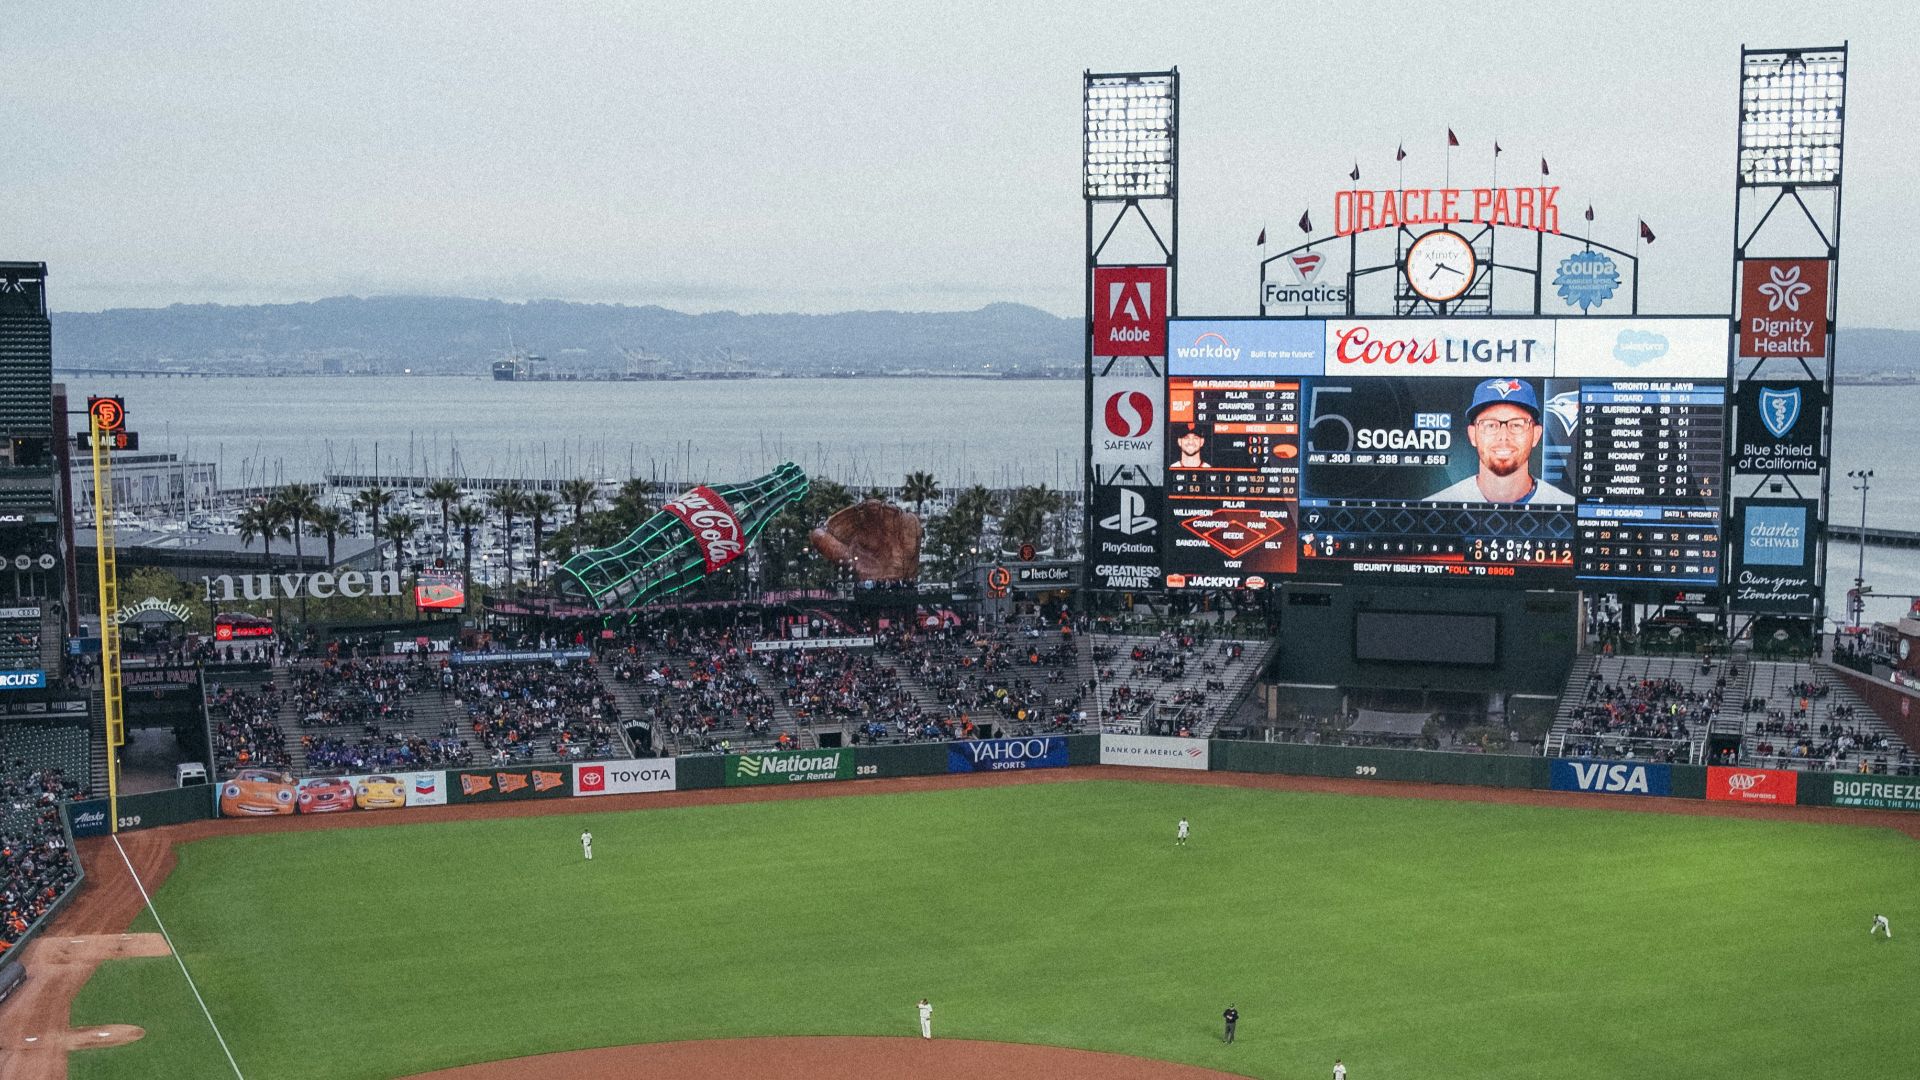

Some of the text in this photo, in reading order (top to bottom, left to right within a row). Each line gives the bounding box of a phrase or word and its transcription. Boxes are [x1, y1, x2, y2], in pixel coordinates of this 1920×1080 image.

[1334, 186, 1560, 238] ORACLE PARK
[1425, 250, 1457, 263] xfinity
[1562, 261, 1614, 279] coupa
[1266, 284, 1346, 302] Fanatics
[1752, 318, 1814, 337] Dignity
[1110, 327, 1150, 342] Adobe
[1336, 326, 1537, 364] Coors LIGHT
[1755, 338, 1810, 352] Health
[1177, 344, 1240, 361] workday
[1193, 380, 1275, 388] SAN FRANCISCO GIANTS
[1612, 382, 1693, 391] TORONTO BLUE JAYS
[1602, 406, 1640, 414] GUERRERO
[1308, 386, 1353, 453] 5
[1417, 413, 1451, 428] ERIC
[1357, 429, 1451, 449] SOGARD
[1611, 429, 1643, 437] GRICHUK
[1104, 440, 1153, 450] SAFEWAY
[1614, 441, 1640, 449] GALVIS
[1743, 444, 1813, 456] Blue Shield
[1615, 464, 1636, 472] DAVIS
[1739, 457, 1817, 470] of California
[1606, 487, 1645, 495] THORNTON
[1173, 509, 1213, 517] WILLIAMSON
[1309, 514, 1319, 523] F7
[1247, 521, 1267, 529] PANIK
[1750, 522, 1799, 537] charles
[1102, 542, 1153, 555] PlayStation
[1176, 539, 1282, 549] SANDOVAL BELT
[1475, 539, 1531, 550] 3 4 4
[1750, 538, 1799, 548] SCHWAB
[1524, 551, 1530, 561] 4
[1535, 550, 1572, 563] 0 1 2
[1224, 560, 1242, 568] VOGT
[1353, 563, 1392, 572] SECURITY
[1393, 564, 1421, 573] ISSUE?
[1423, 565, 1443, 573] TEXT
[1475, 566, 1486, 575] TO
[1095, 564, 1161, 578] GREATNESS
[202, 570, 402, 601] nuveen
[1189, 576, 1240, 587] JACKPOT
[1739, 570, 1807, 592] Own your
[1737, 586, 1810, 600] tomorrow
[113, 597, 194, 624] Ghirardelli
[968, 738, 1049, 763] YAHOO!
[1105, 746, 1184, 757] BANK OF AMERICA
[761, 752, 840, 774] National
[992, 761, 1026, 770] SPORTS
[610, 769, 671, 783] TOYOTA
[788, 771, 837, 782] Car Rental
[856, 765, 877, 775] 382
[1355, 765, 1377, 776] 399
[1569, 763, 1649, 793] VISA
[1731, 775, 1753, 788] AAA
[1833, 781, 1920, 800] BIOFREEZE
[1863, 798, 1884, 807] COOL
[1888, 800, 1902, 808] THE
[75, 811, 105, 823] Alaska
[119, 815, 141, 828] 339
